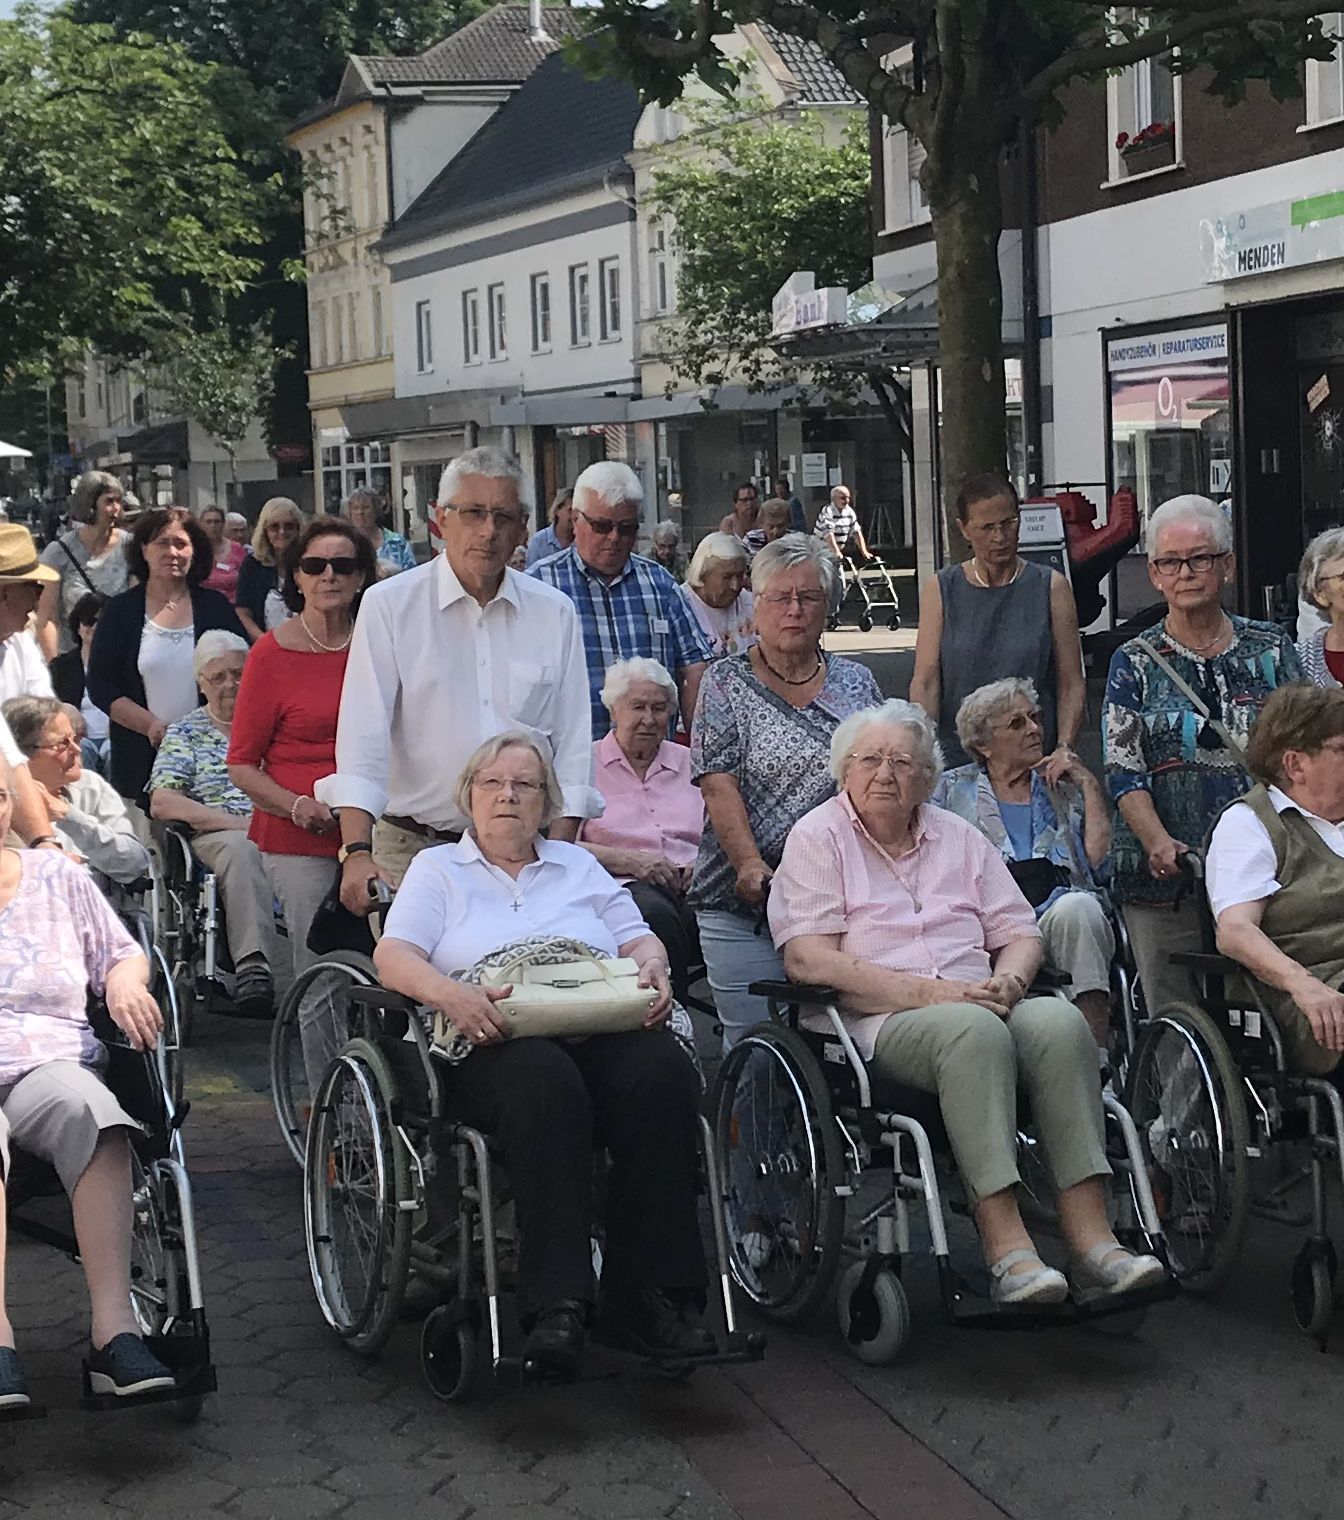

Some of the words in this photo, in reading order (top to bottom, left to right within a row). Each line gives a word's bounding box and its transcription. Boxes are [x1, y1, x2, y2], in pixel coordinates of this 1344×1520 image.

[1238, 242, 1286, 272] MENDEN
[1110, 341, 1156, 361] HANDYZUBEHÖR
[1162, 333, 1225, 355] REPARATURSERVICE
